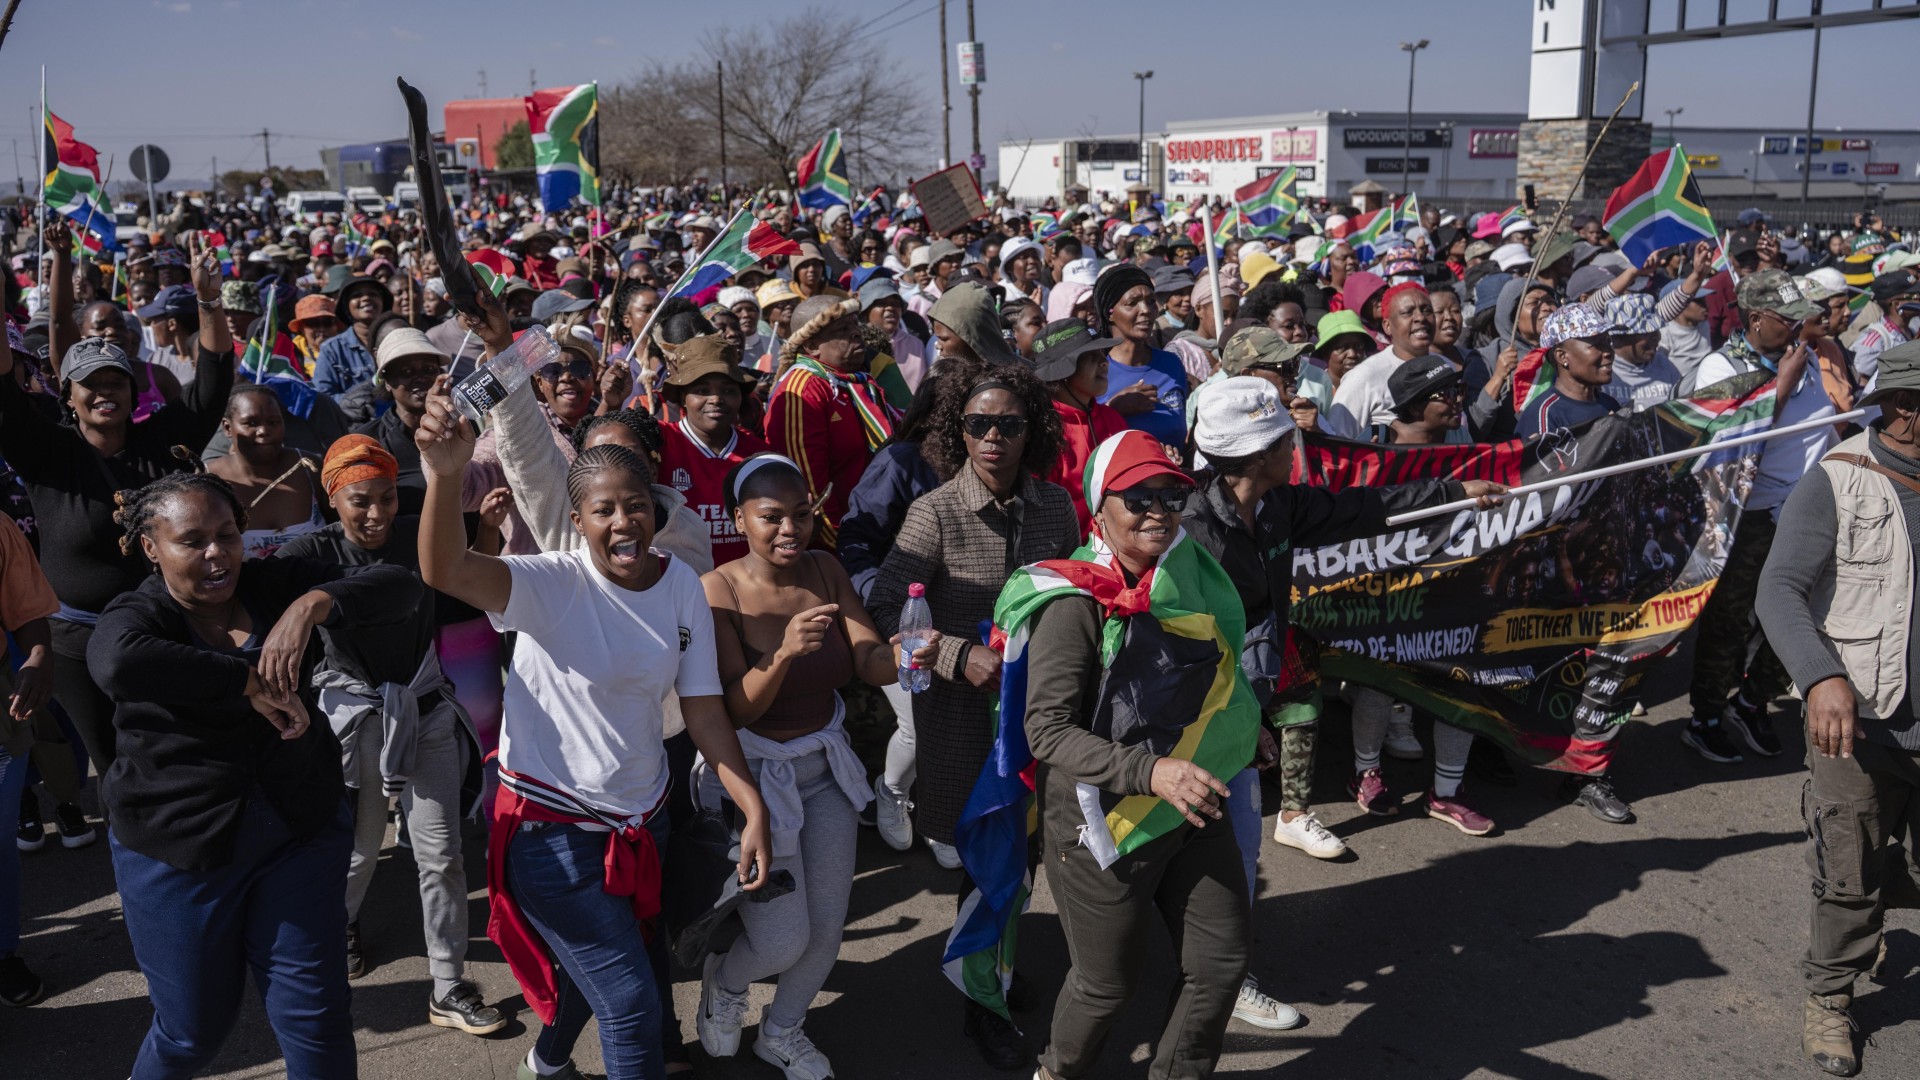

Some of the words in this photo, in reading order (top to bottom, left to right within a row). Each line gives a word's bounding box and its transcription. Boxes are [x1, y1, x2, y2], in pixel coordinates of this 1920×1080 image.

[1166, 137, 1262, 161] SHOPRITE
[1346, 130, 1426, 143] WOOLWORHS
[464, 386, 490, 414] POWER
[1506, 614, 1573, 644] TOGETHER
[1578, 610, 1605, 636] WE
[1367, 624, 1479, 663] RE-AWAKENED!
[1587, 709, 1606, 727] NO
